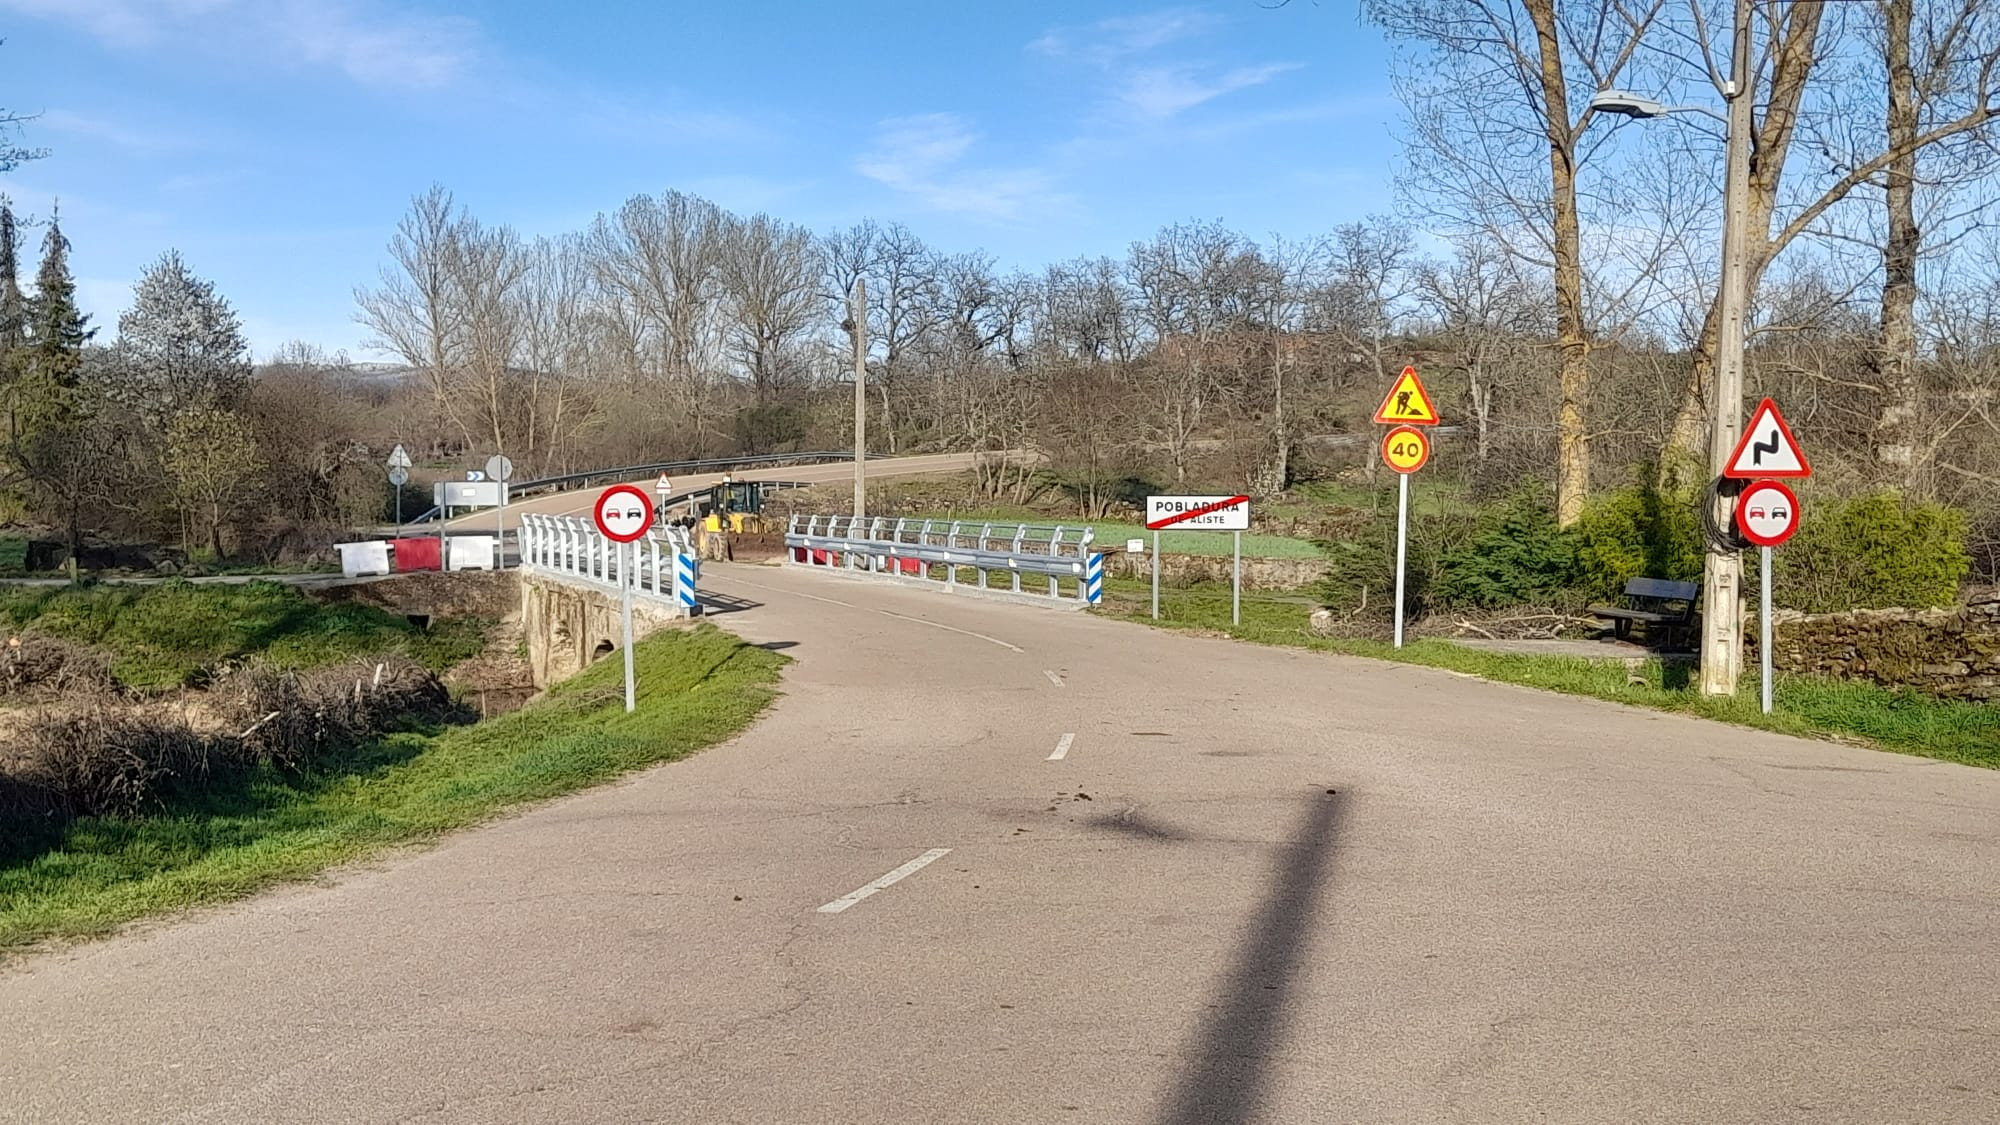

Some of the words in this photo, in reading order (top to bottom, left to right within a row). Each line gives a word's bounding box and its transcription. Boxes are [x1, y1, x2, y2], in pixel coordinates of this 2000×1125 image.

[1392, 442, 1419, 457] 40
[1156, 501, 1239, 512] POBLADURA
[1190, 516, 1225, 524] ALISTE
